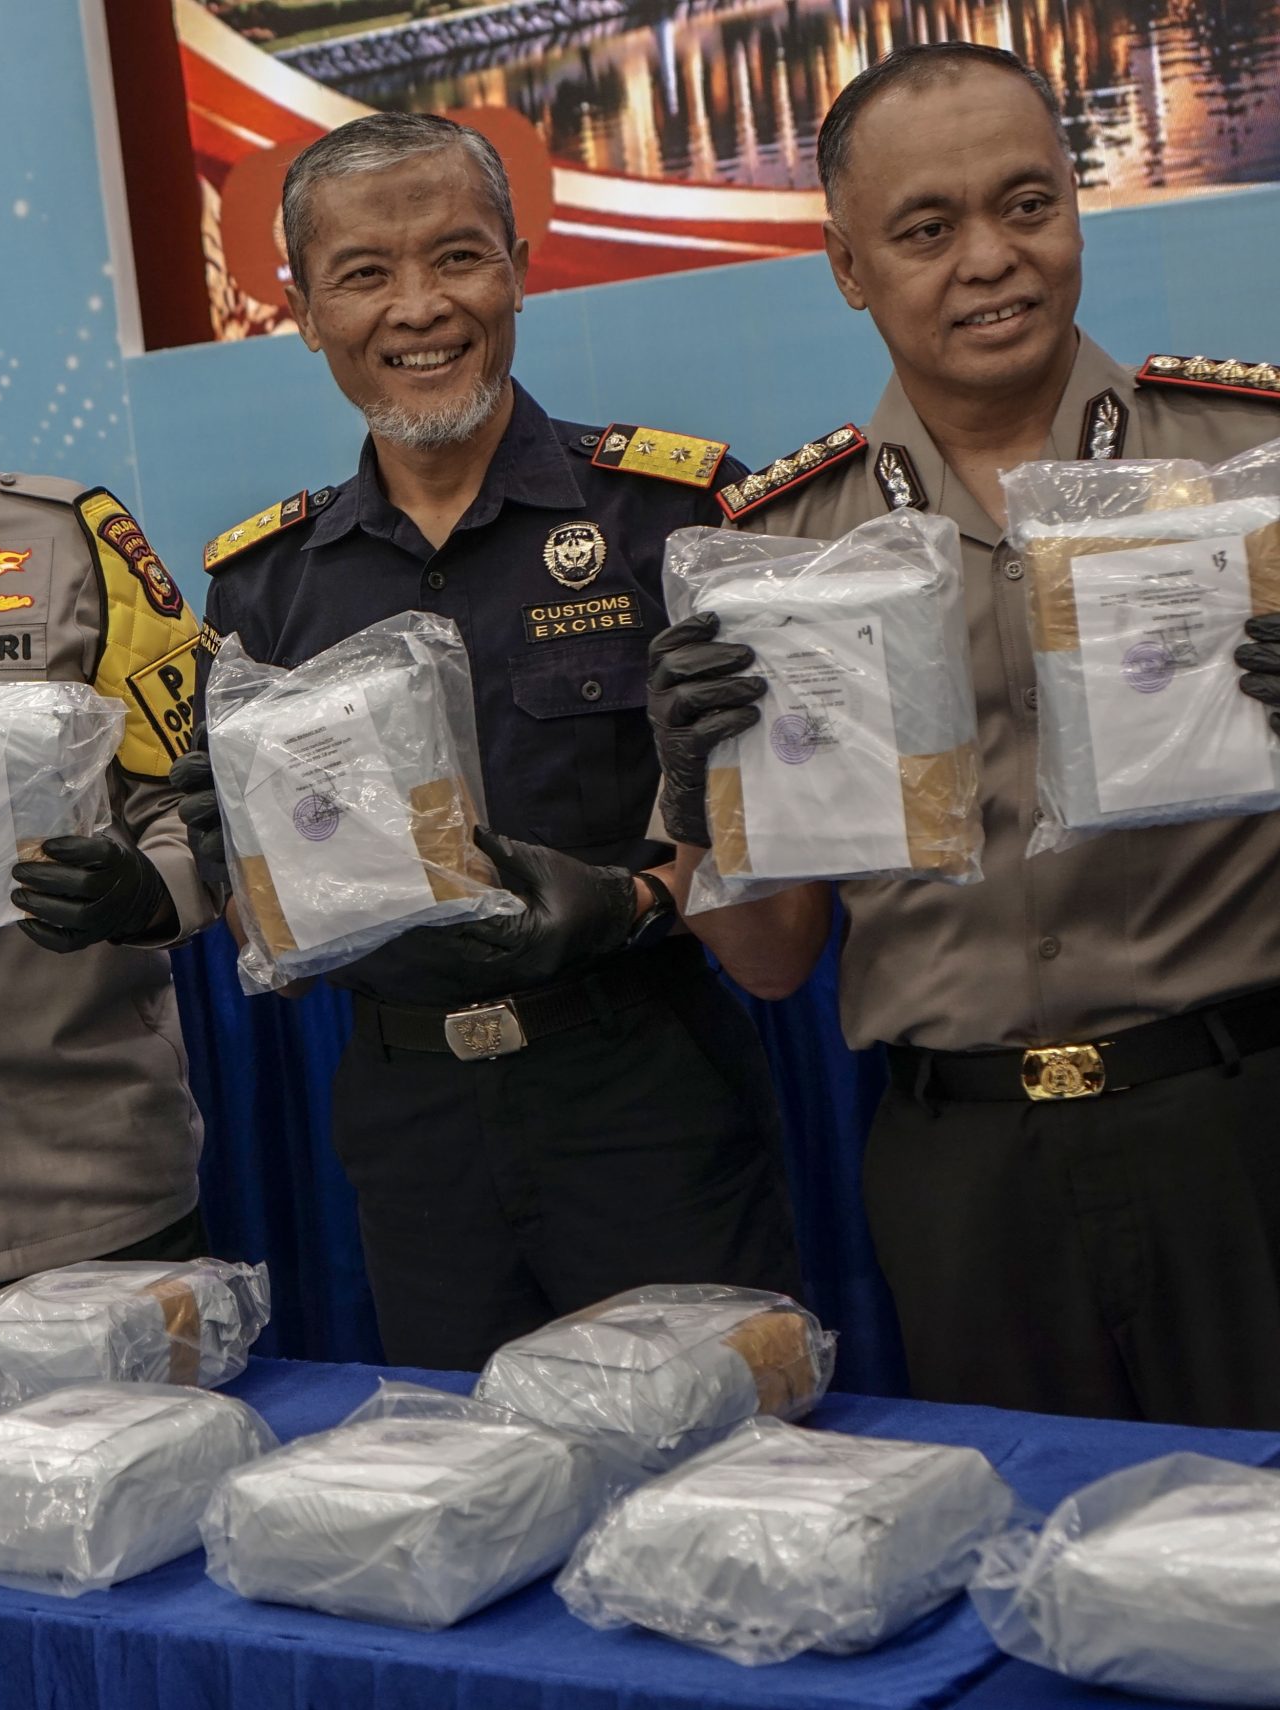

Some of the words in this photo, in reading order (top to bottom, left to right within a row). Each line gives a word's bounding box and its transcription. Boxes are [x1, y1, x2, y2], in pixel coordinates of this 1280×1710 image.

[108, 520, 137, 541] POLDA
[124, 537, 144, 553] RIAU
[531, 596, 630, 621] CUSTOMS
[535, 613, 633, 637] EXCISE
